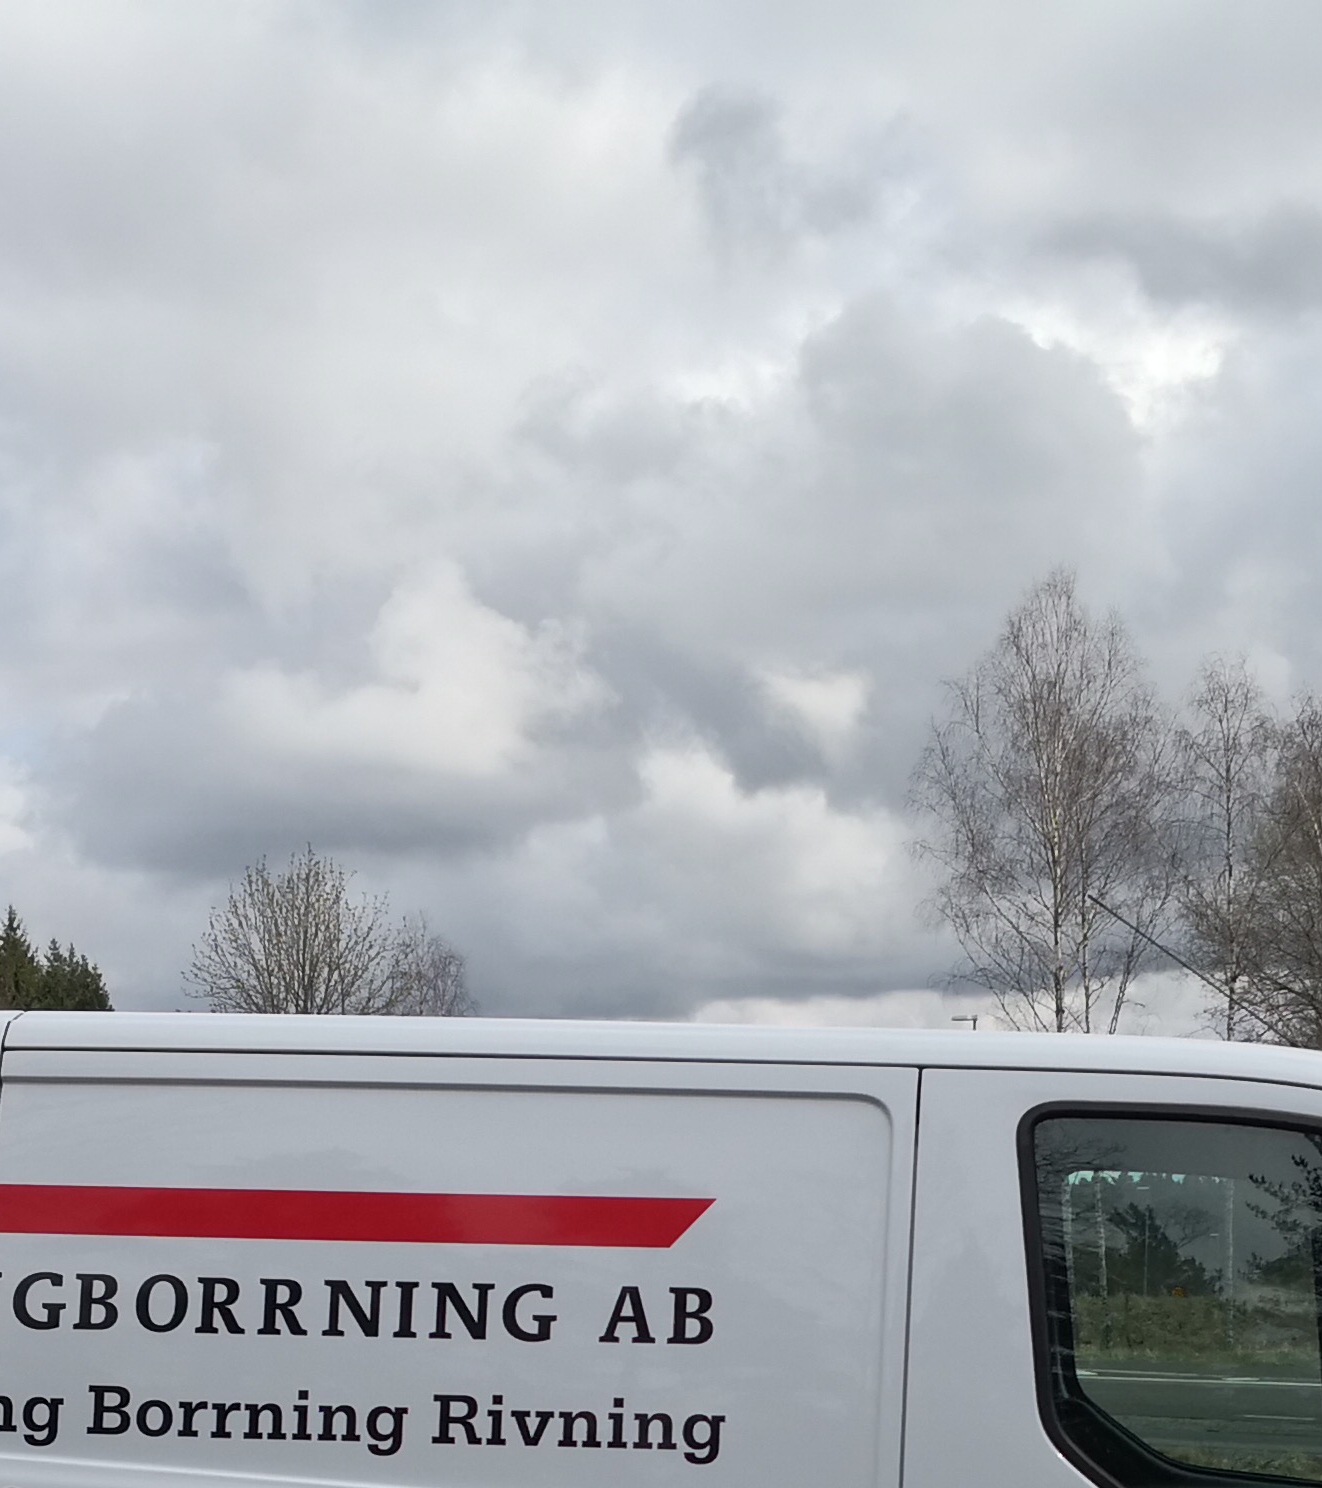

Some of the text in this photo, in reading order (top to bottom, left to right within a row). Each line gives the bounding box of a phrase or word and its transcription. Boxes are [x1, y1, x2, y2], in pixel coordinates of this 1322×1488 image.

[598, 1285, 715, 1345] AB
[86, 1384, 409, 1457] Borrning
[431, 1394, 726, 1465] Rivning
